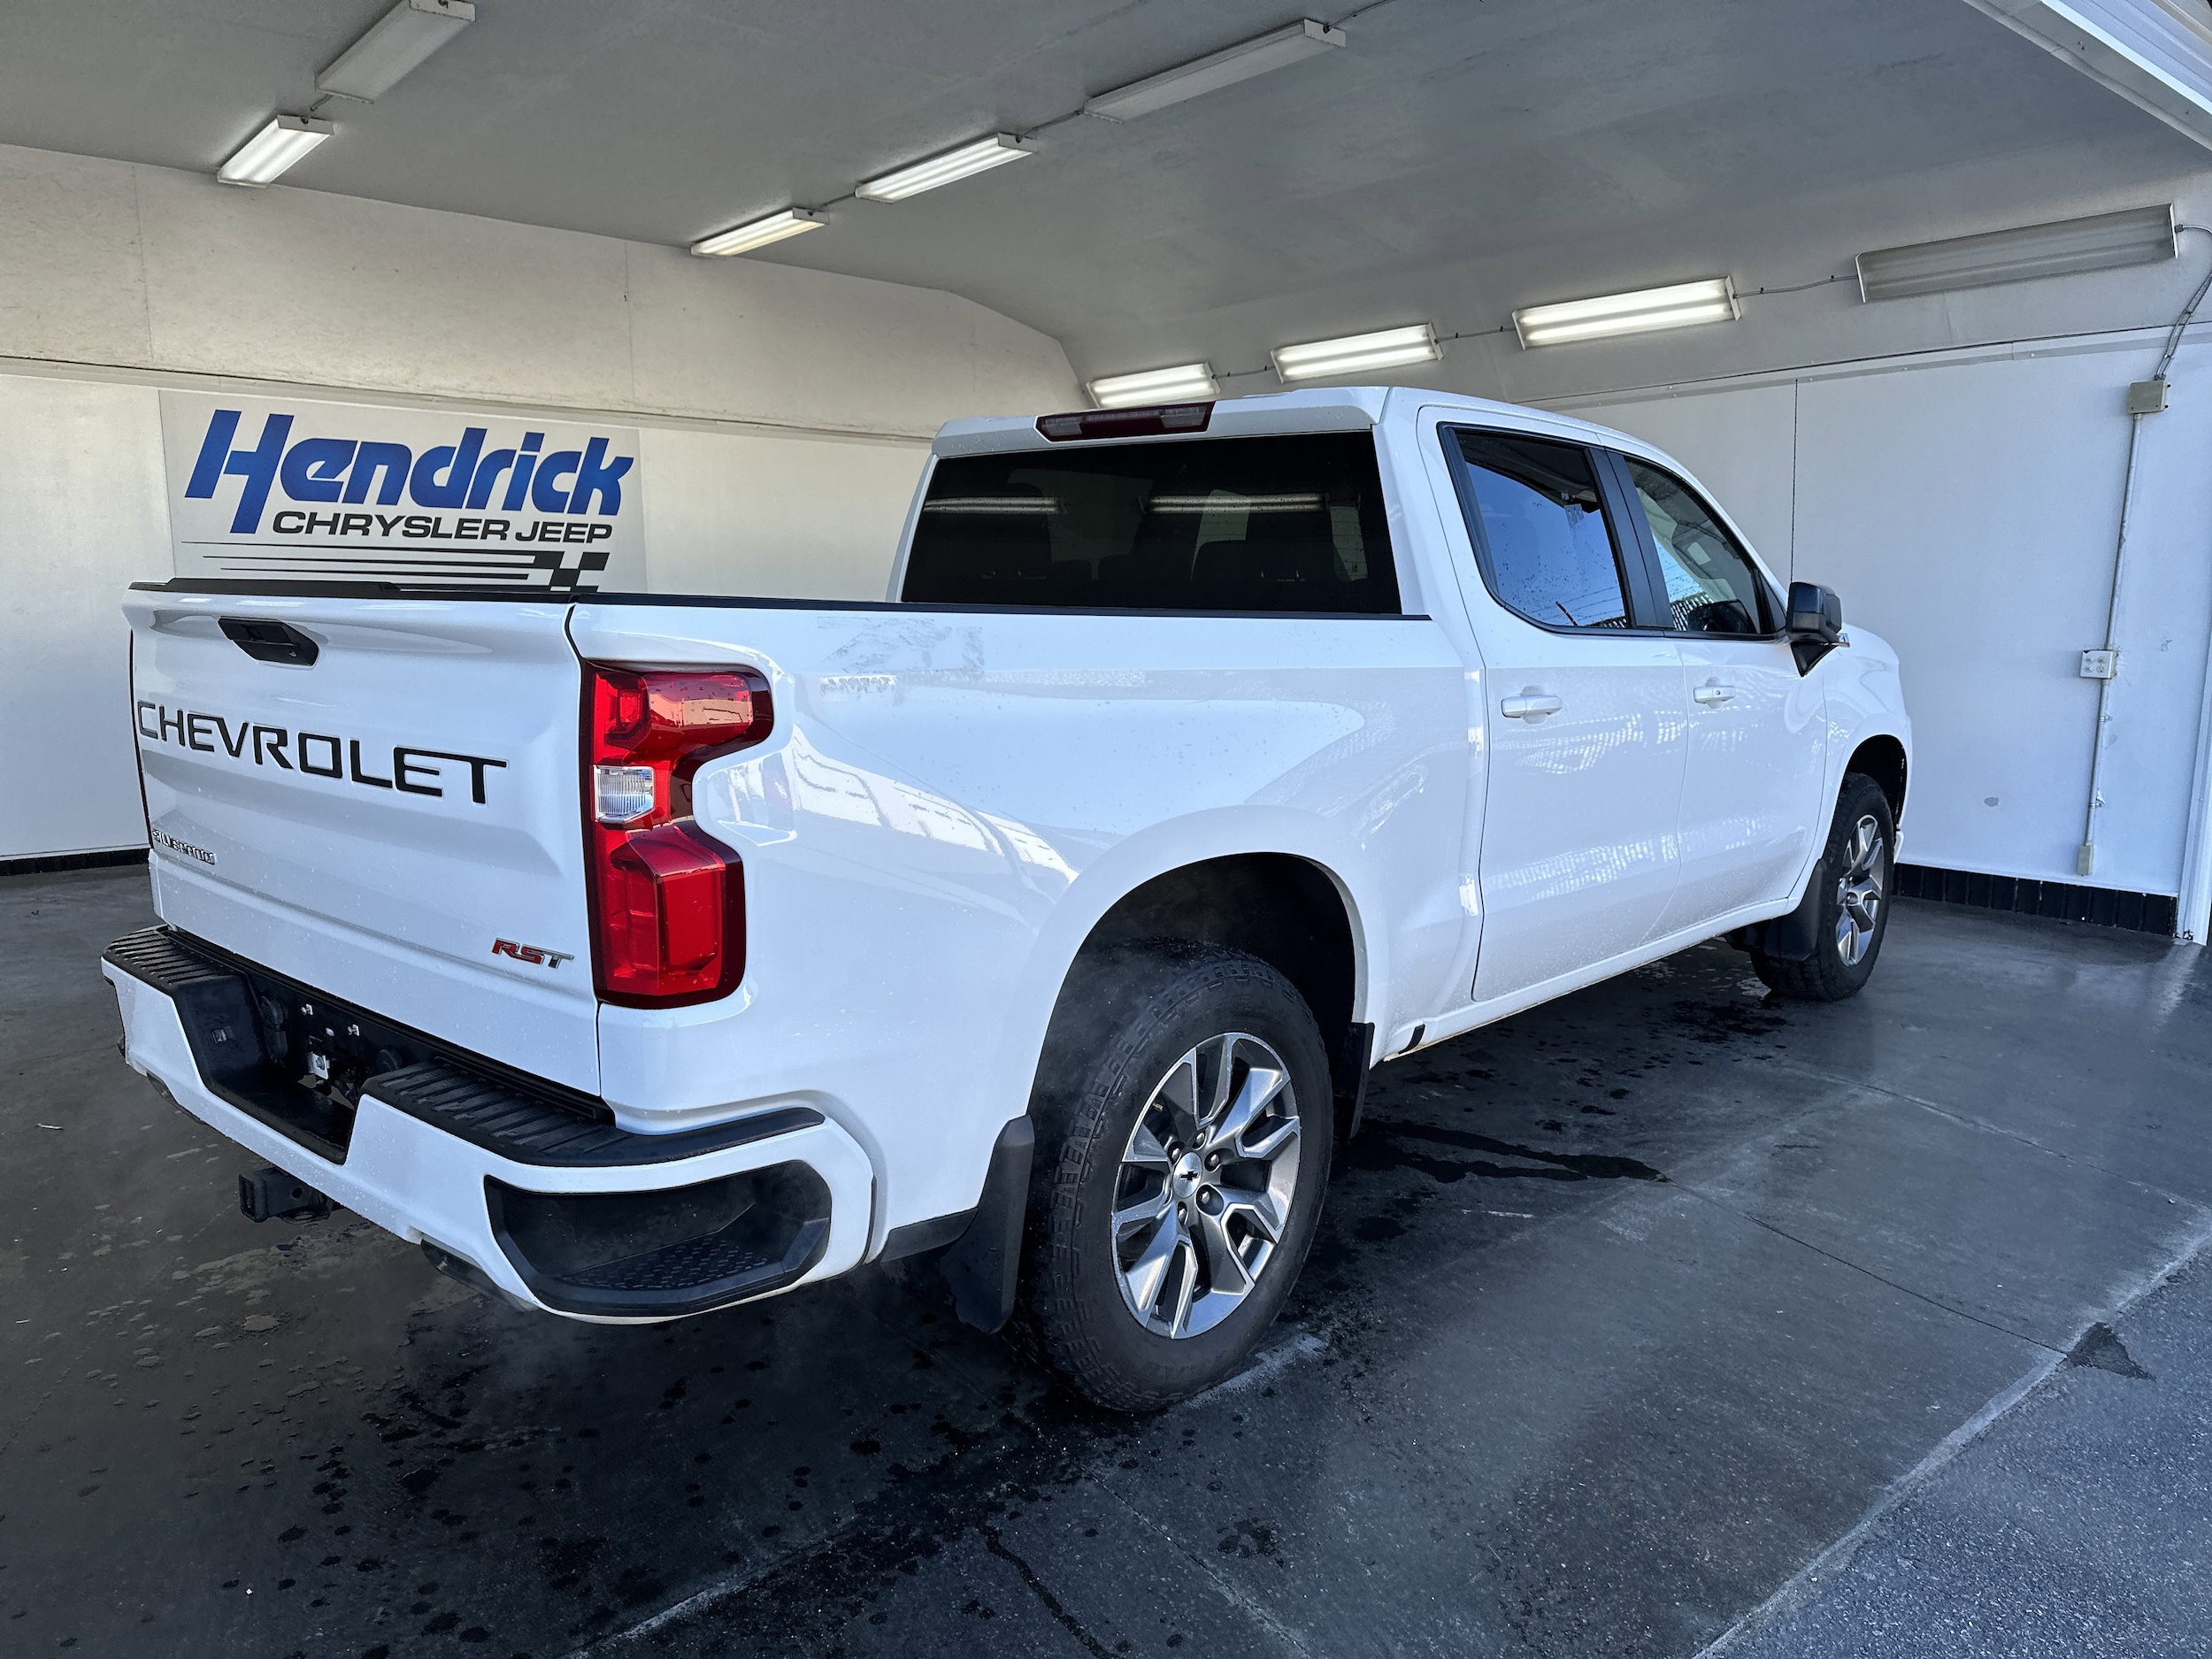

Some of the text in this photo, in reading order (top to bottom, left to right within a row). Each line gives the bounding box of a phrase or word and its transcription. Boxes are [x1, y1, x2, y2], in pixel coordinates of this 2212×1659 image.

[185, 410, 634, 534] Hendrick
[273, 511, 612, 544] CHRYSLER JEEP
[137, 700, 508, 804] CHEVROLET
[491, 937, 575, 969] RST
